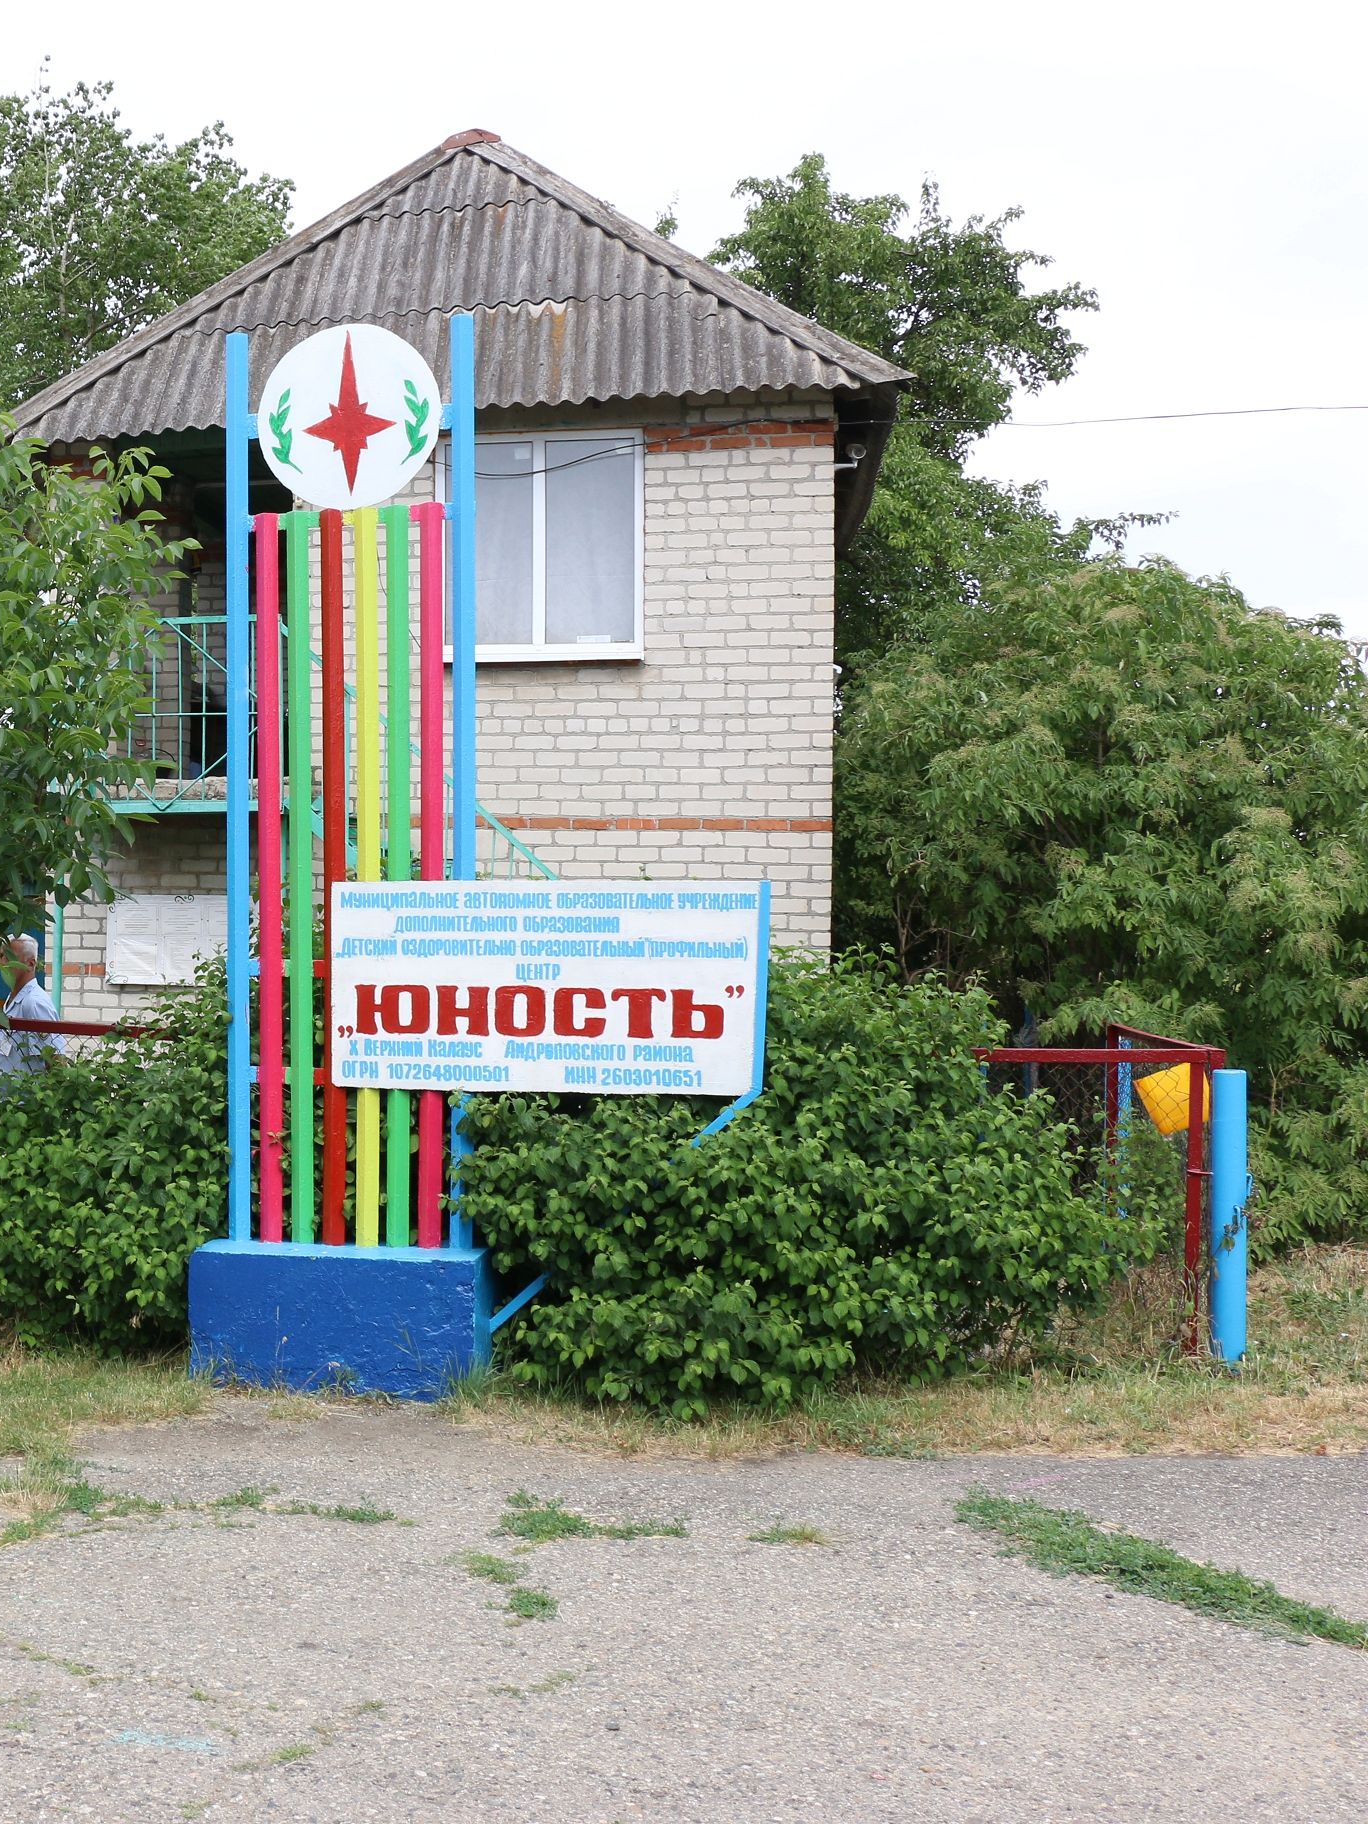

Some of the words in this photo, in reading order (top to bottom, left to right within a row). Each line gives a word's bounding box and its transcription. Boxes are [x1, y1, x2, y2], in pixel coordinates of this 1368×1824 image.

[340, 891, 460, 911] МУНИЦИПАЛЬНОЕ
[464, 892, 552, 909] АВТОНОМНОЕ
[556, 892, 674, 910] ОБРАЗОВАТЕЛЬНОЕ
[678, 892, 758, 912] УЧРЕЖДЕНИЕ
[393, 915, 518, 933] ДОПОЛНИТЕЛЬНОГО
[523, 916, 620, 933] ОБРАЗОВАНИЯ
[516, 963, 561, 982] ЦЕНТР
[342, 1060, 379, 1079] ОГРН
[386, 1063, 510, 1082] 1072648000501
[564, 1066, 597, 1084] ИНН
[600, 1068, 702, 1087] 2603010651
